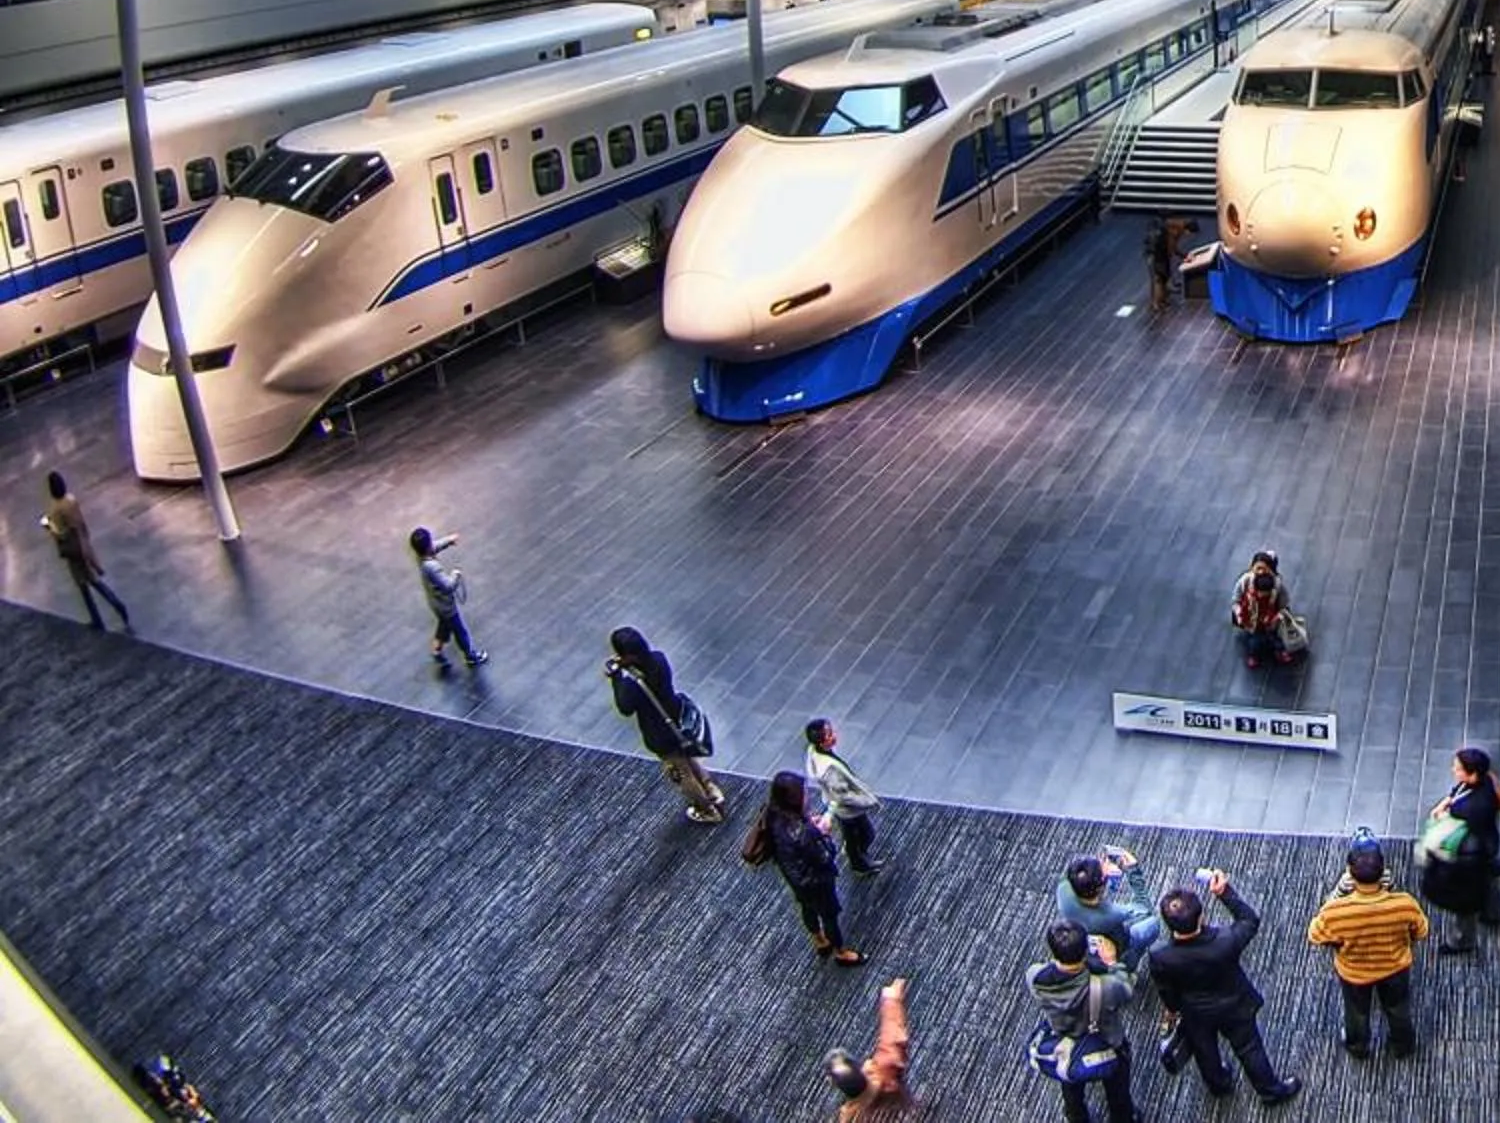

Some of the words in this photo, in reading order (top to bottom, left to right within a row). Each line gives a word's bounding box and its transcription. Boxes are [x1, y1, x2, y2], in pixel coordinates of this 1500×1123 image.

[1187, 713, 1219, 728] 2011
[1241, 718, 1251, 731] 3
[1273, 722, 1290, 735] 18
